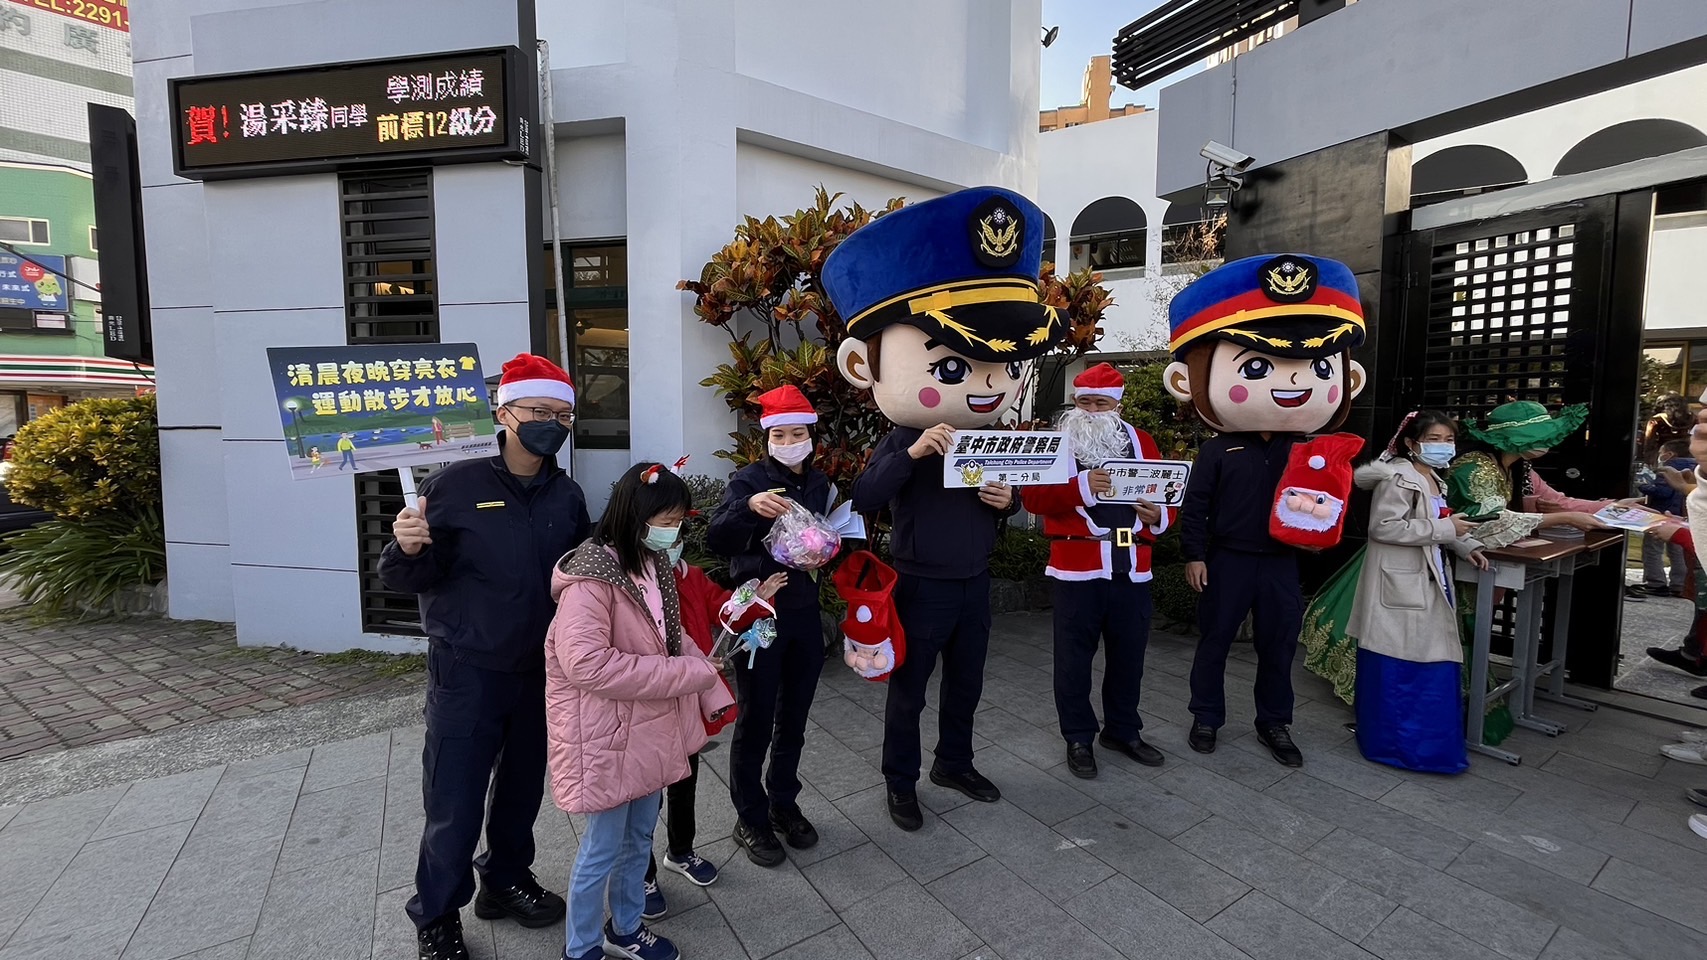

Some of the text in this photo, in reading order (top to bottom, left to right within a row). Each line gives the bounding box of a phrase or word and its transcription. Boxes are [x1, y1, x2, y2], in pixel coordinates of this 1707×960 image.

[387, 68, 485, 104] 學測成績
[376, 105, 497, 144] 前標12級分
[287, 357, 458, 387] 清晨夜晚穿亮衣
[312, 385, 478, 416] 運動散步才放心
[953, 435, 1062, 454] 臺中市政府警察局
[1027, 458, 1053, 466] Department
[998, 472, 1041, 482] 第二分局
[1122, 483, 1158, 496] 非常讚
